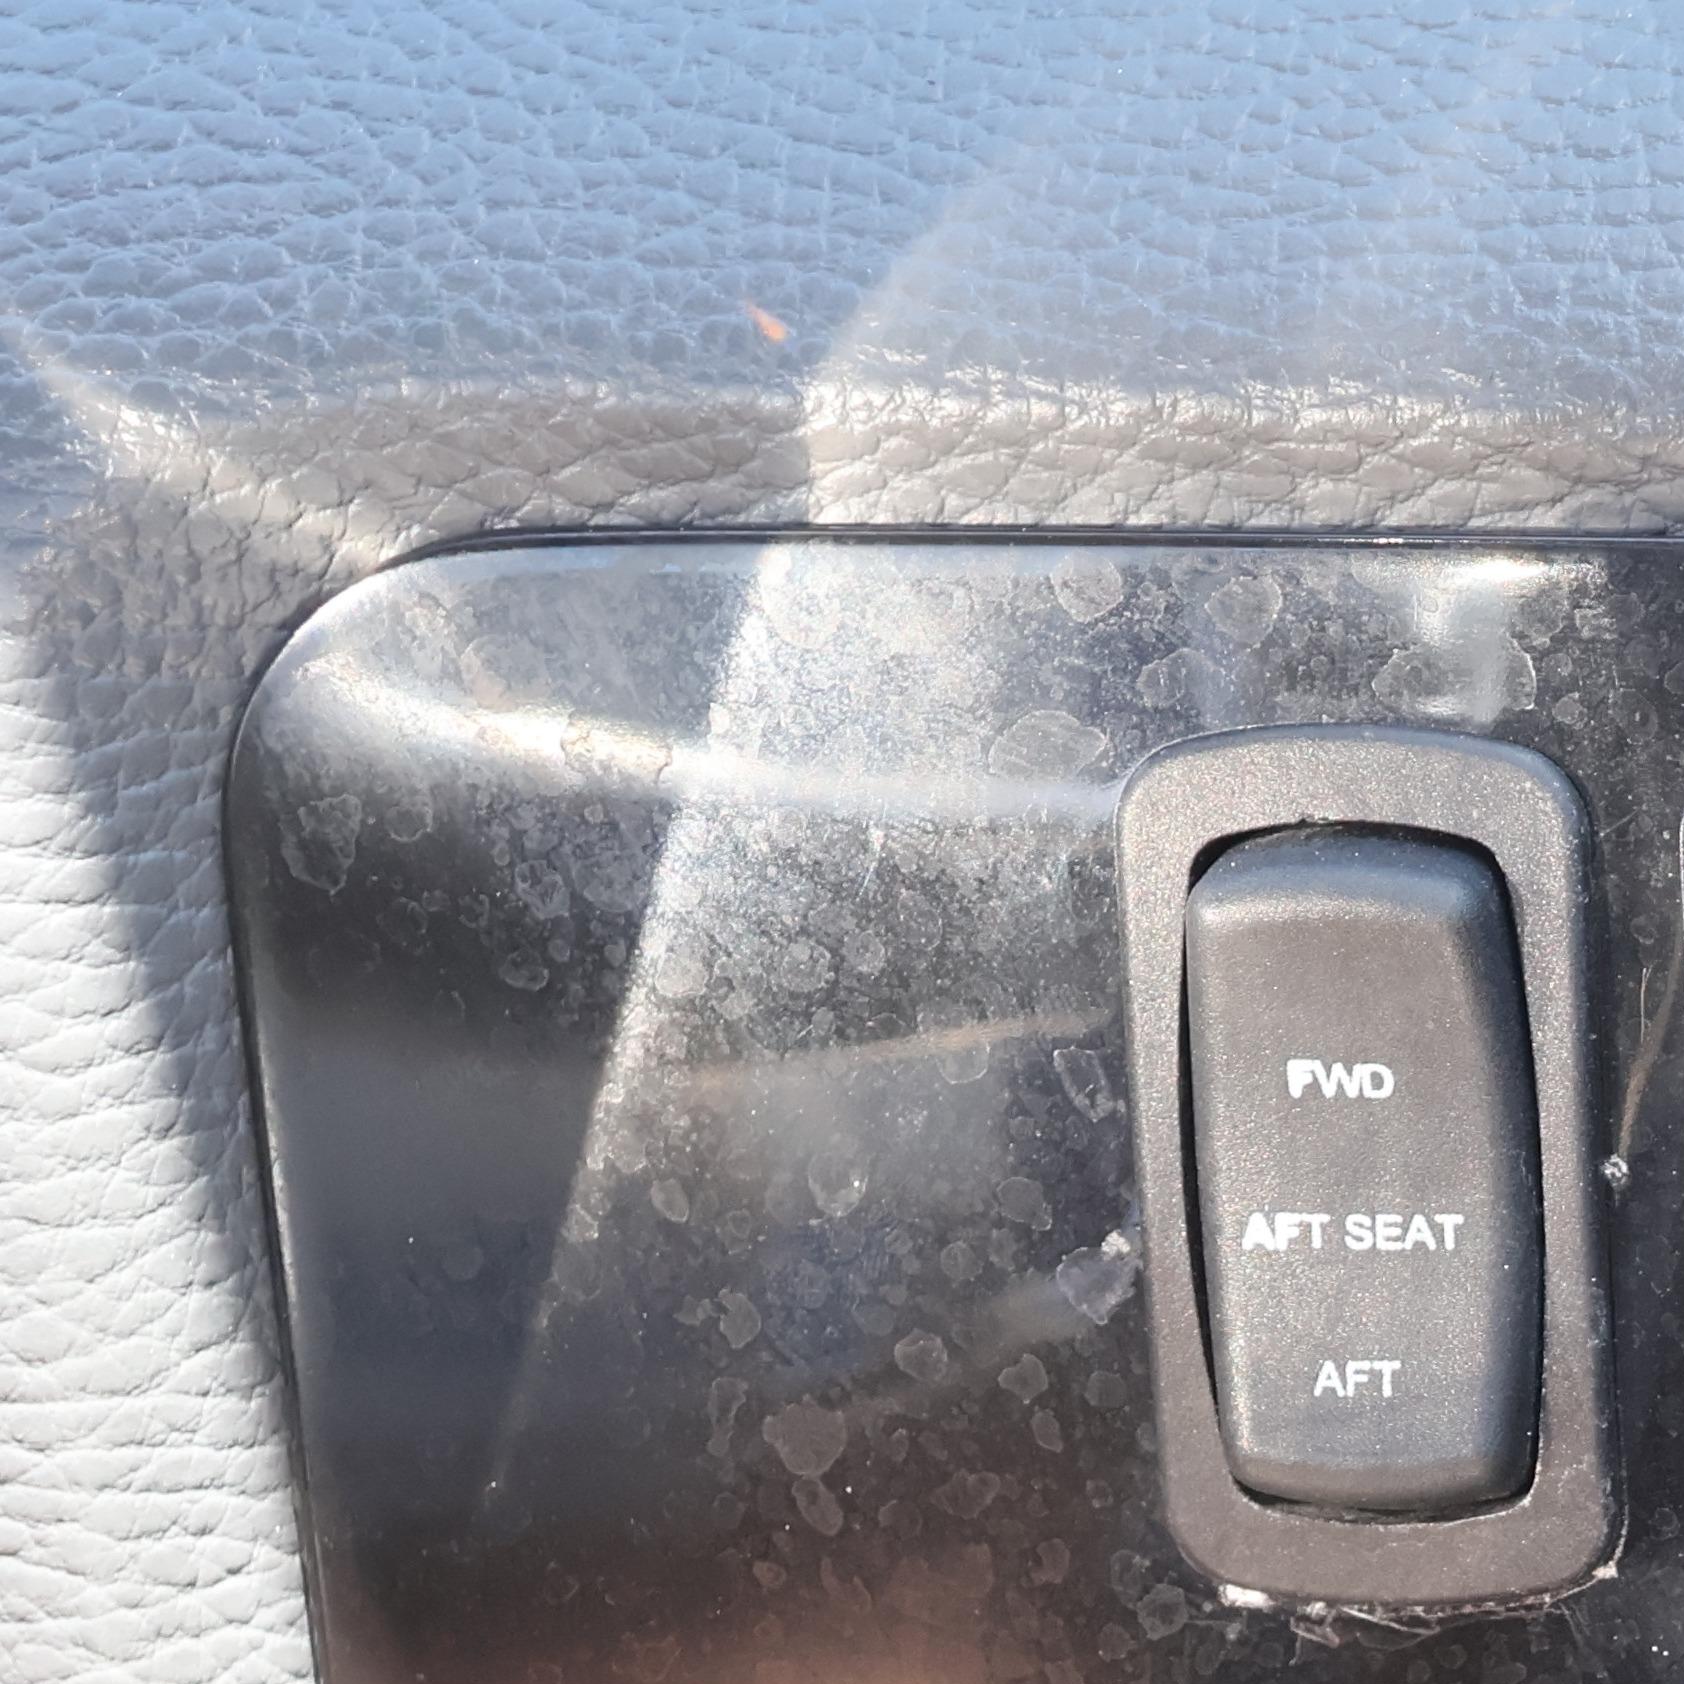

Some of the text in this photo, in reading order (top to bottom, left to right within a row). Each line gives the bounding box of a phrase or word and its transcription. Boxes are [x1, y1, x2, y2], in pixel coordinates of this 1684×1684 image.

[1286, 1058, 1395, 1099] FWD
[1241, 1213, 1464, 1252] AFT SEAT
[1313, 1359, 1401, 1398] AFT
